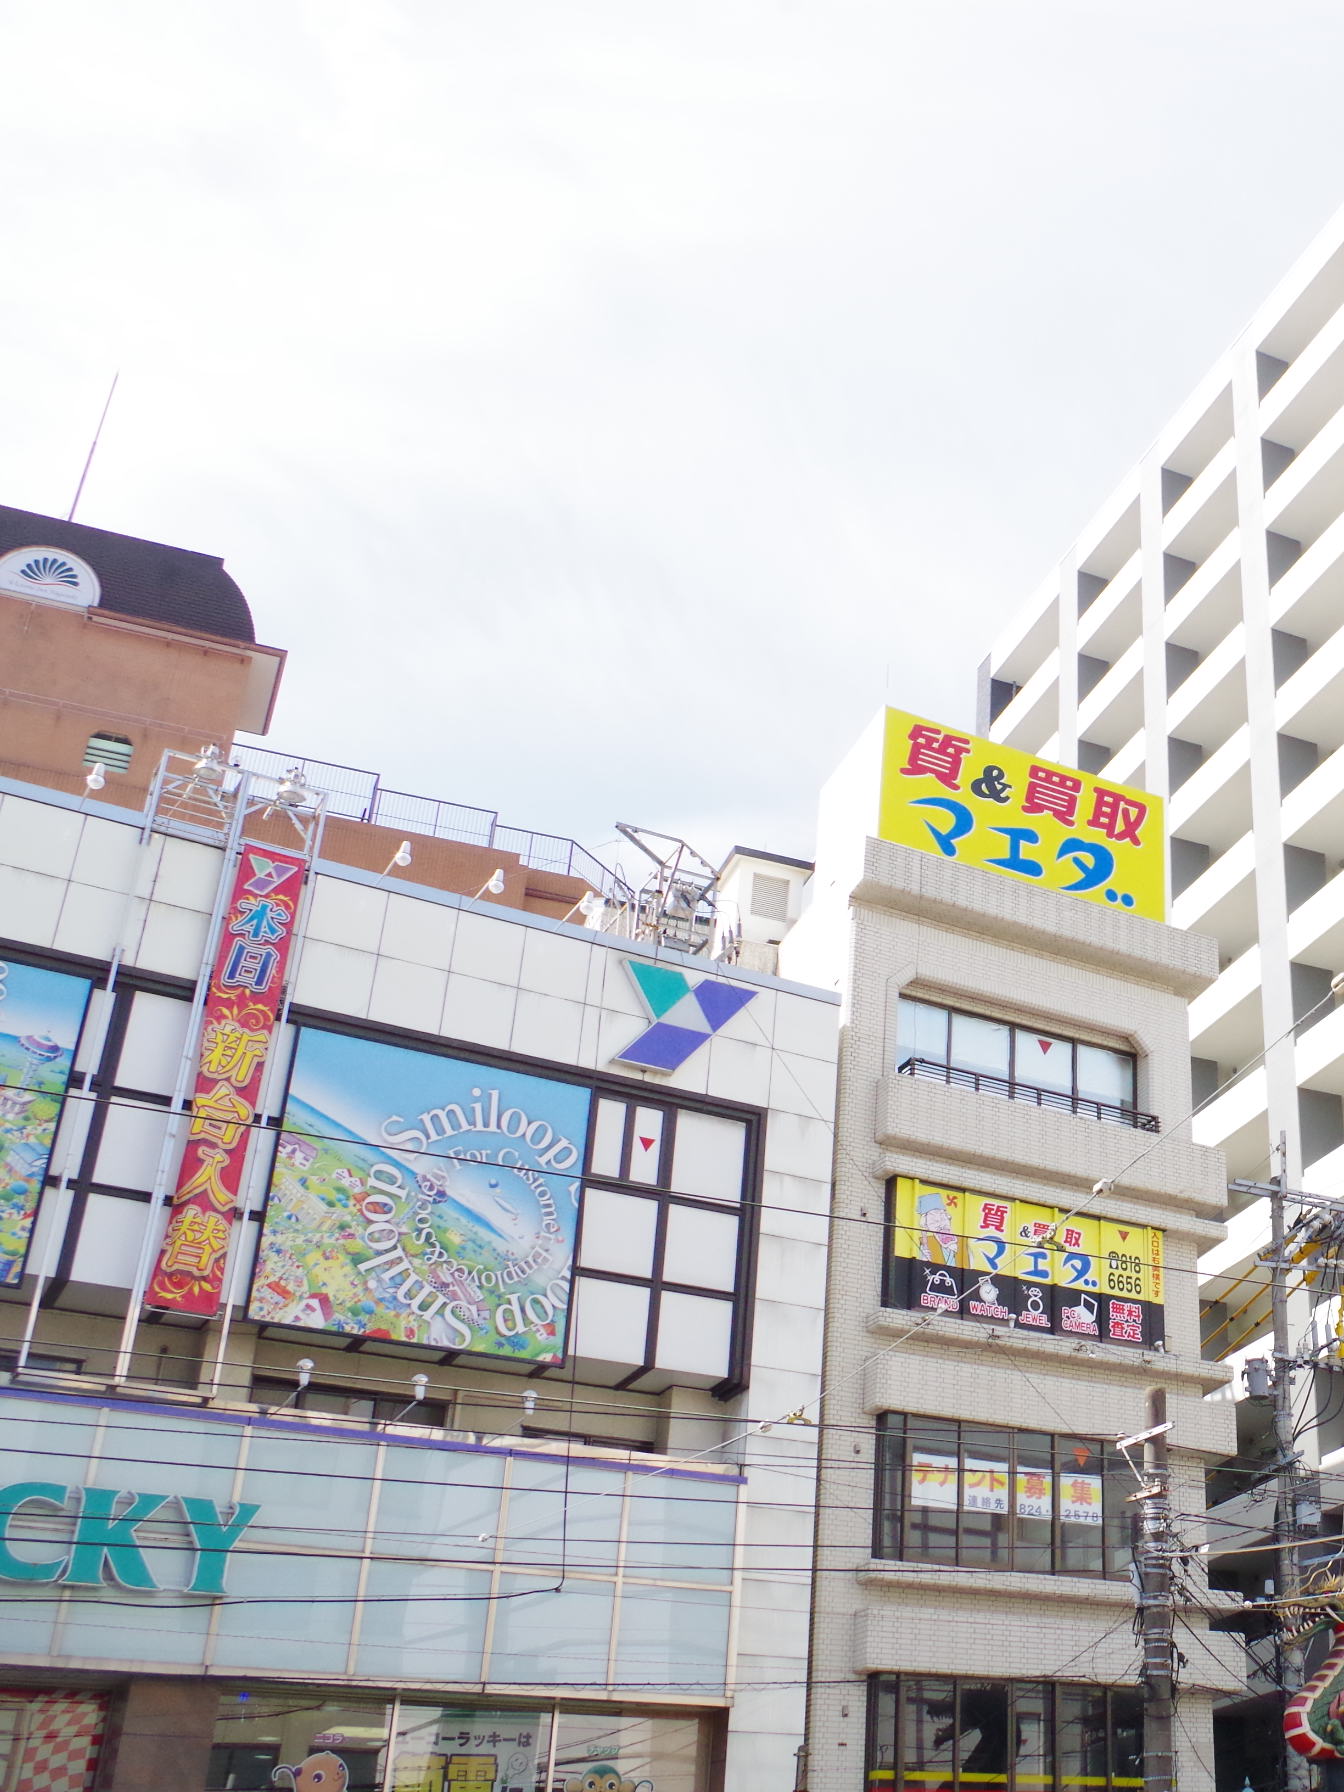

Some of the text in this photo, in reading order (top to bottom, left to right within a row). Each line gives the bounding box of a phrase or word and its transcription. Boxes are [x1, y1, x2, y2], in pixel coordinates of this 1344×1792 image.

[899, 723, 1148, 847] 質&買取
[908, 796, 1136, 908] マエダ
[161, 899, 290, 1277] 本日 新台入替
[381, 1087, 578, 1170] Smiloop
[448, 1146, 491, 1169] For
[498, 1148, 557, 1243] Customer
[357, 1163, 480, 1349] Smiloop
[424, 1239, 448, 1262] &
[973, 1234, 1098, 1288] マエダ
[443, 1246, 552, 1292] Employee
[1107, 1272, 1142, 1295] 6656
[921, 1294, 960, 1312] BRAND
[969, 1301, 1009, 1320] WATCH
[1019, 1311, 1051, 1327] JEWEL
[1110, 1300, 1142, 1323] 無料
[1061, 1319, 1099, 1336] CAMERA
[1109, 1320, 1142, 1341] 査定
[0, 1482, 262, 1596] CKY
